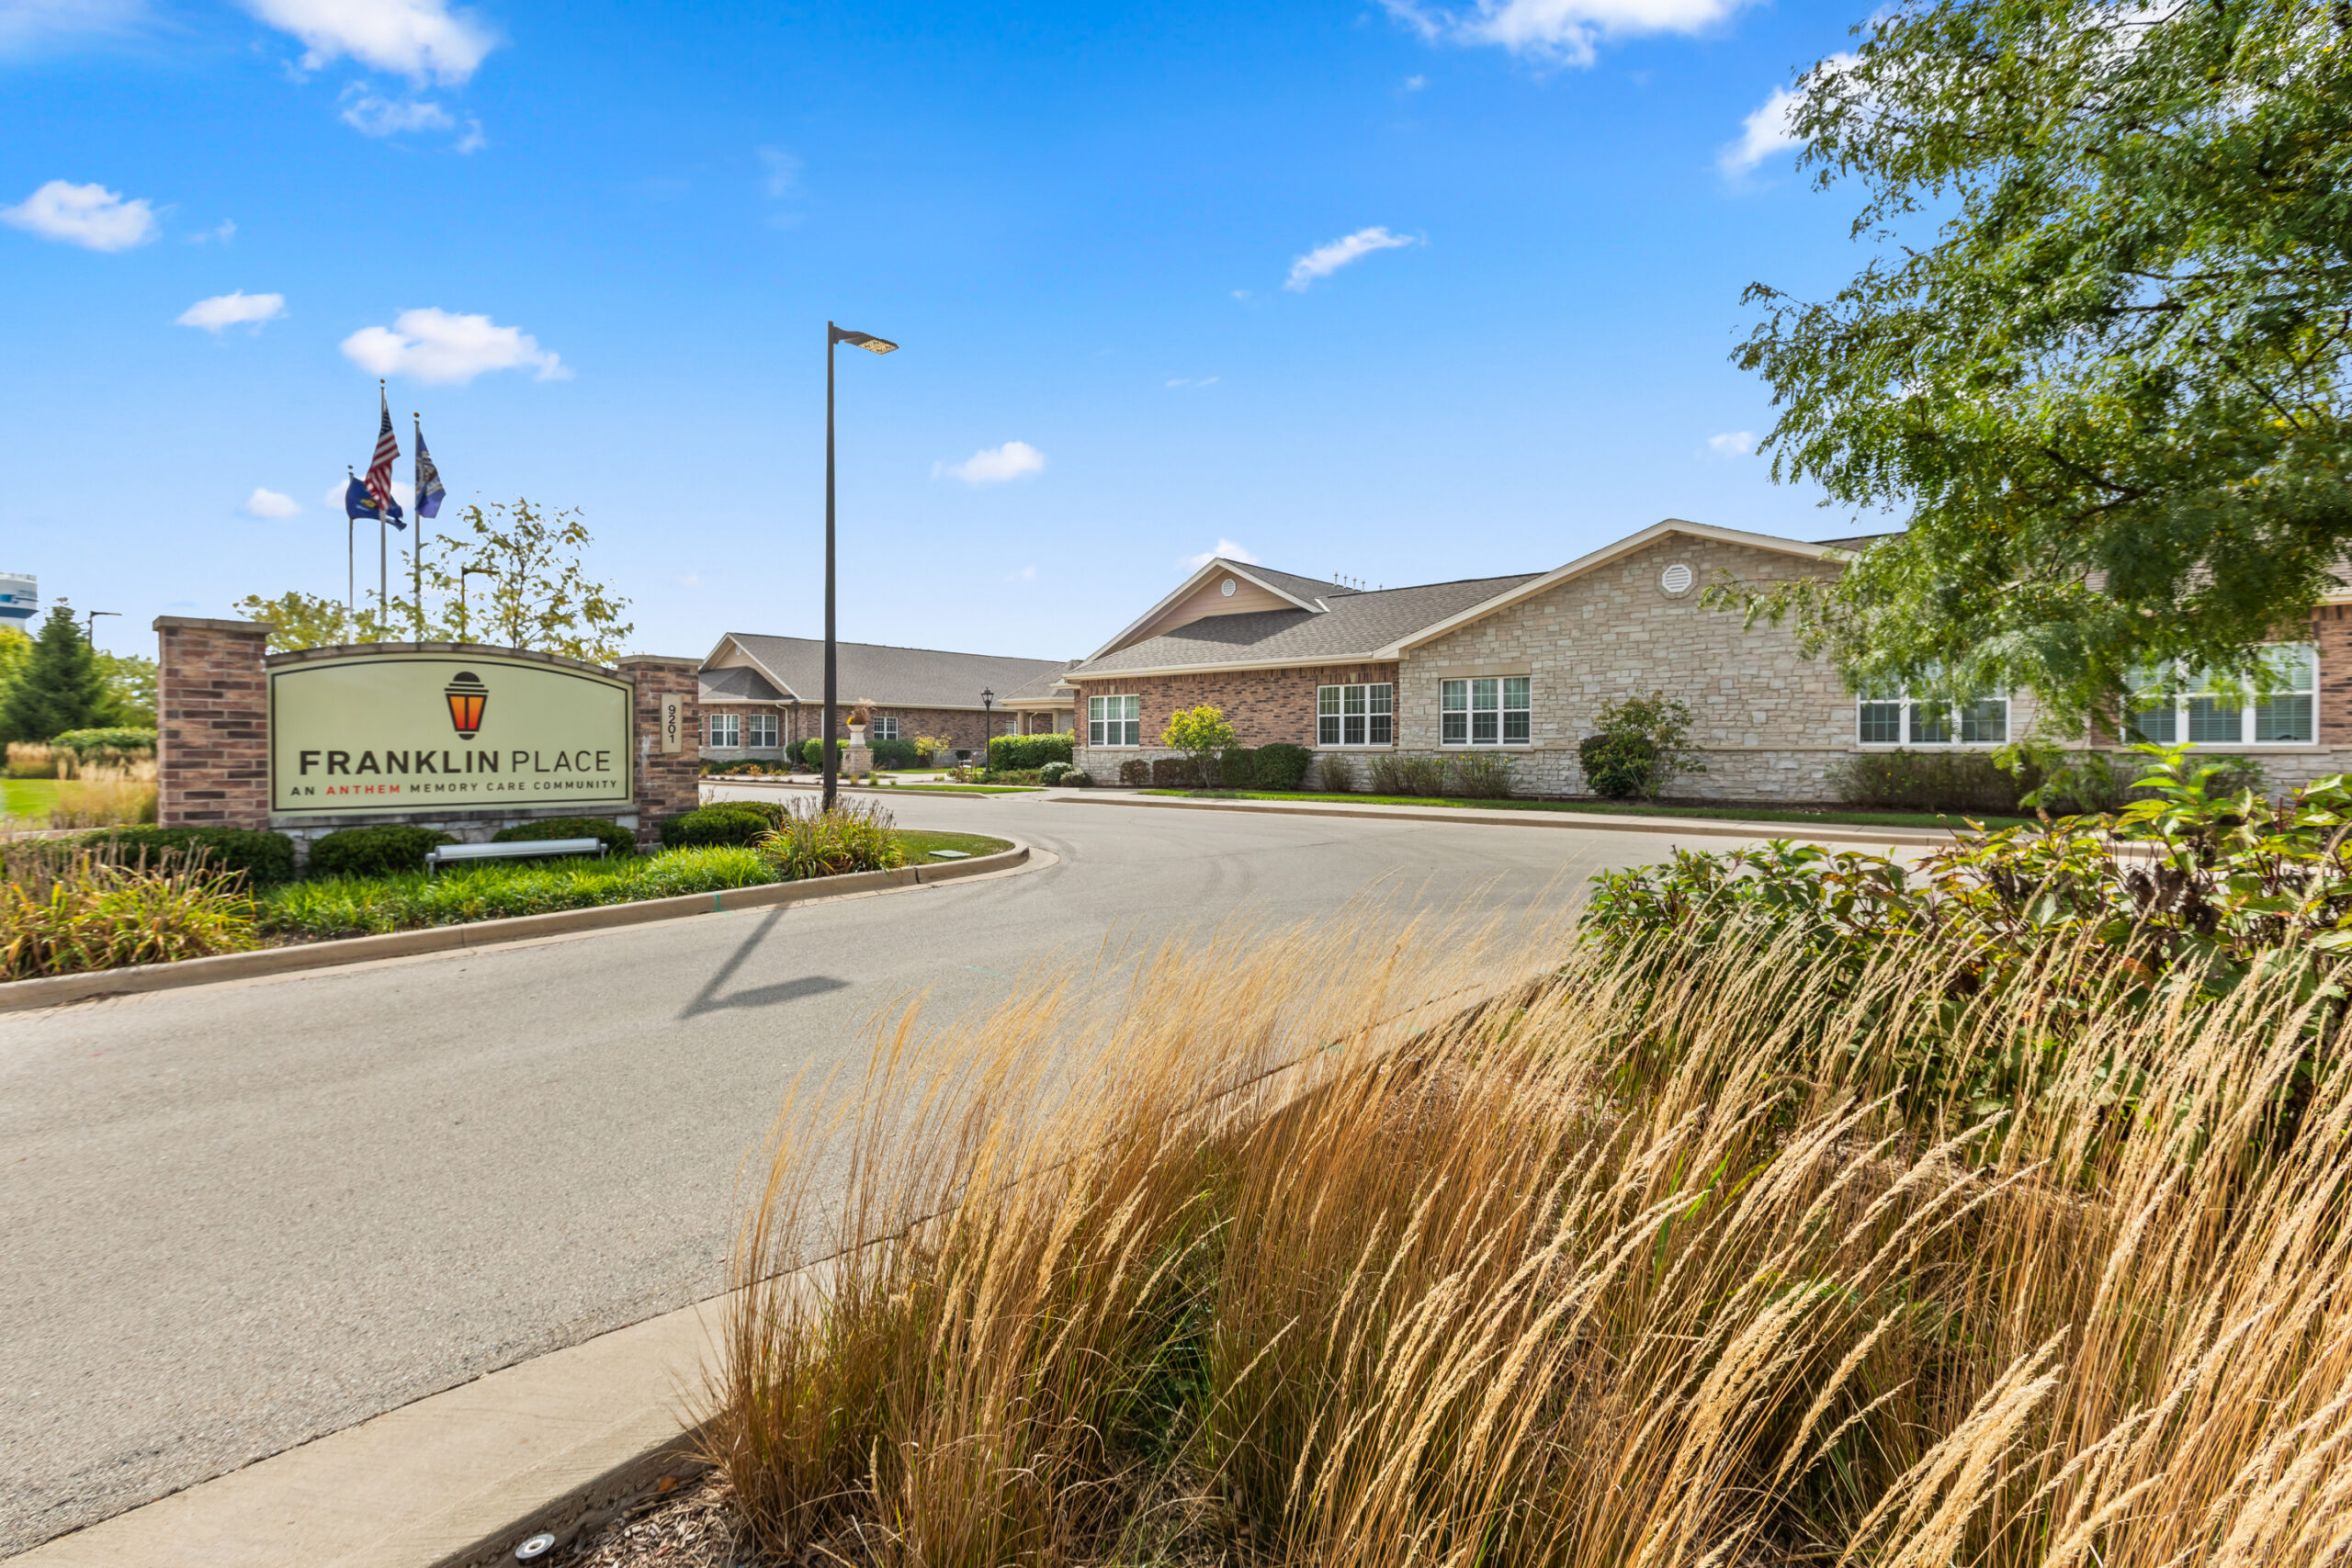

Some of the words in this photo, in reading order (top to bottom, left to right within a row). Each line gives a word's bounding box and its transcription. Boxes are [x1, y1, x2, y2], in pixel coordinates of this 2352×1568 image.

[667, 705, 676, 743] 9201
[299, 750, 499, 775] FRANKLIN
[512, 750, 611, 773] PLACE
[290, 786, 315, 795] AN
[325, 784, 401, 795] ANTHEM
[410, 783, 478, 794] MEMORY
[486, 782, 526, 791] CARE
[533, 780, 617, 790] COMMUNITY
